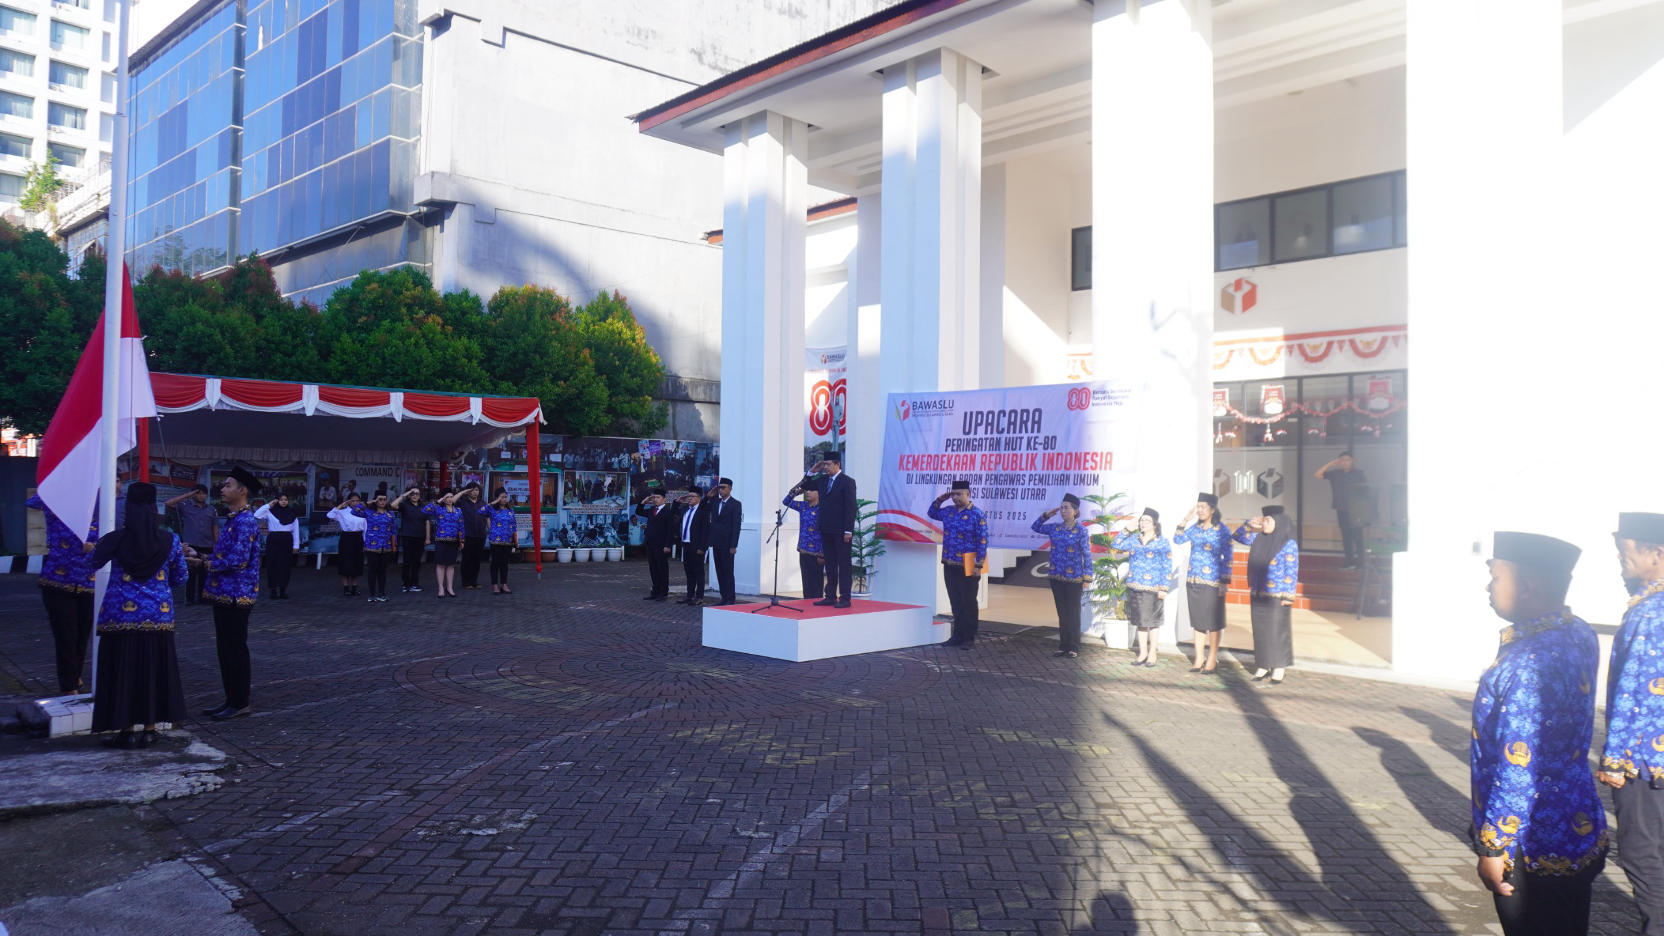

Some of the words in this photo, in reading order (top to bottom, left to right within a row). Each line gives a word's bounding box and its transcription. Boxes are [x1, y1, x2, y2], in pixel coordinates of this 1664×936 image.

[912, 399, 955, 410] BAWASLU
[962, 408, 1042, 435] UPACARA
[945, 437, 1001, 452] PERINGATAN
[1003, 436, 1024, 451] HUT
[1026, 435, 1057, 451] KE-80
[898, 453, 976, 471] KEMERDEKAAN
[980, 453, 1038, 471] REPUBLIK
[1041, 452, 1113, 471] INDONESIA
[355, 467, 393, 477] COMMAND
[906, 473, 914, 485] DI
[915, 473, 957, 485] LINGKUNGAN
[984, 473, 1026, 486] PENGAWAS
[1028, 473, 1071, 486] PEMILIHAN
[1073, 473, 1100, 486] UMUM
[980, 487, 1019, 500] SULAWESI
[1020, 488, 1047, 500] UTARA
[1006, 511, 1027, 521] 2025
